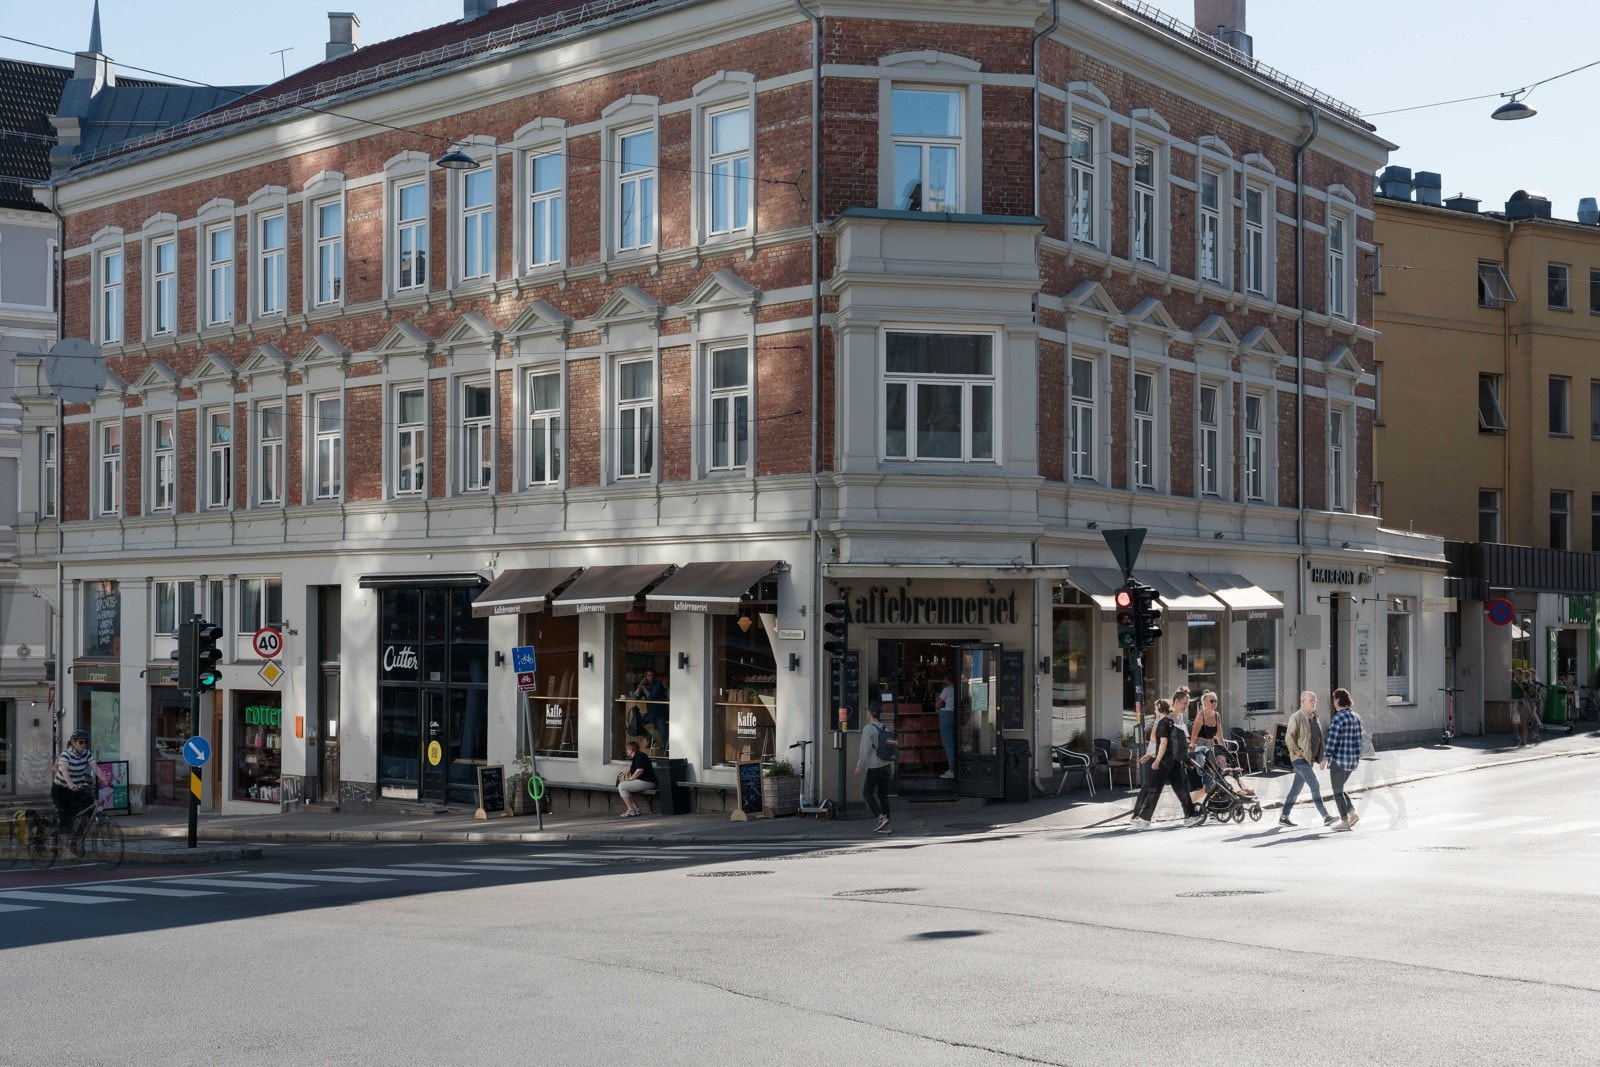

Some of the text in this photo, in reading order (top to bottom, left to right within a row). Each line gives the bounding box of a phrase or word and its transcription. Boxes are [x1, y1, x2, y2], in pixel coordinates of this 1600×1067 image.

[1312, 569, 1355, 584] HAIRPORT
[259, 635, 278, 650] 40
[383, 645, 418, 672] Cutter
[245, 706, 282, 726] røtter
[546, 703, 563, 718] Kaffe
[737, 711, 757, 727] Kaffe
